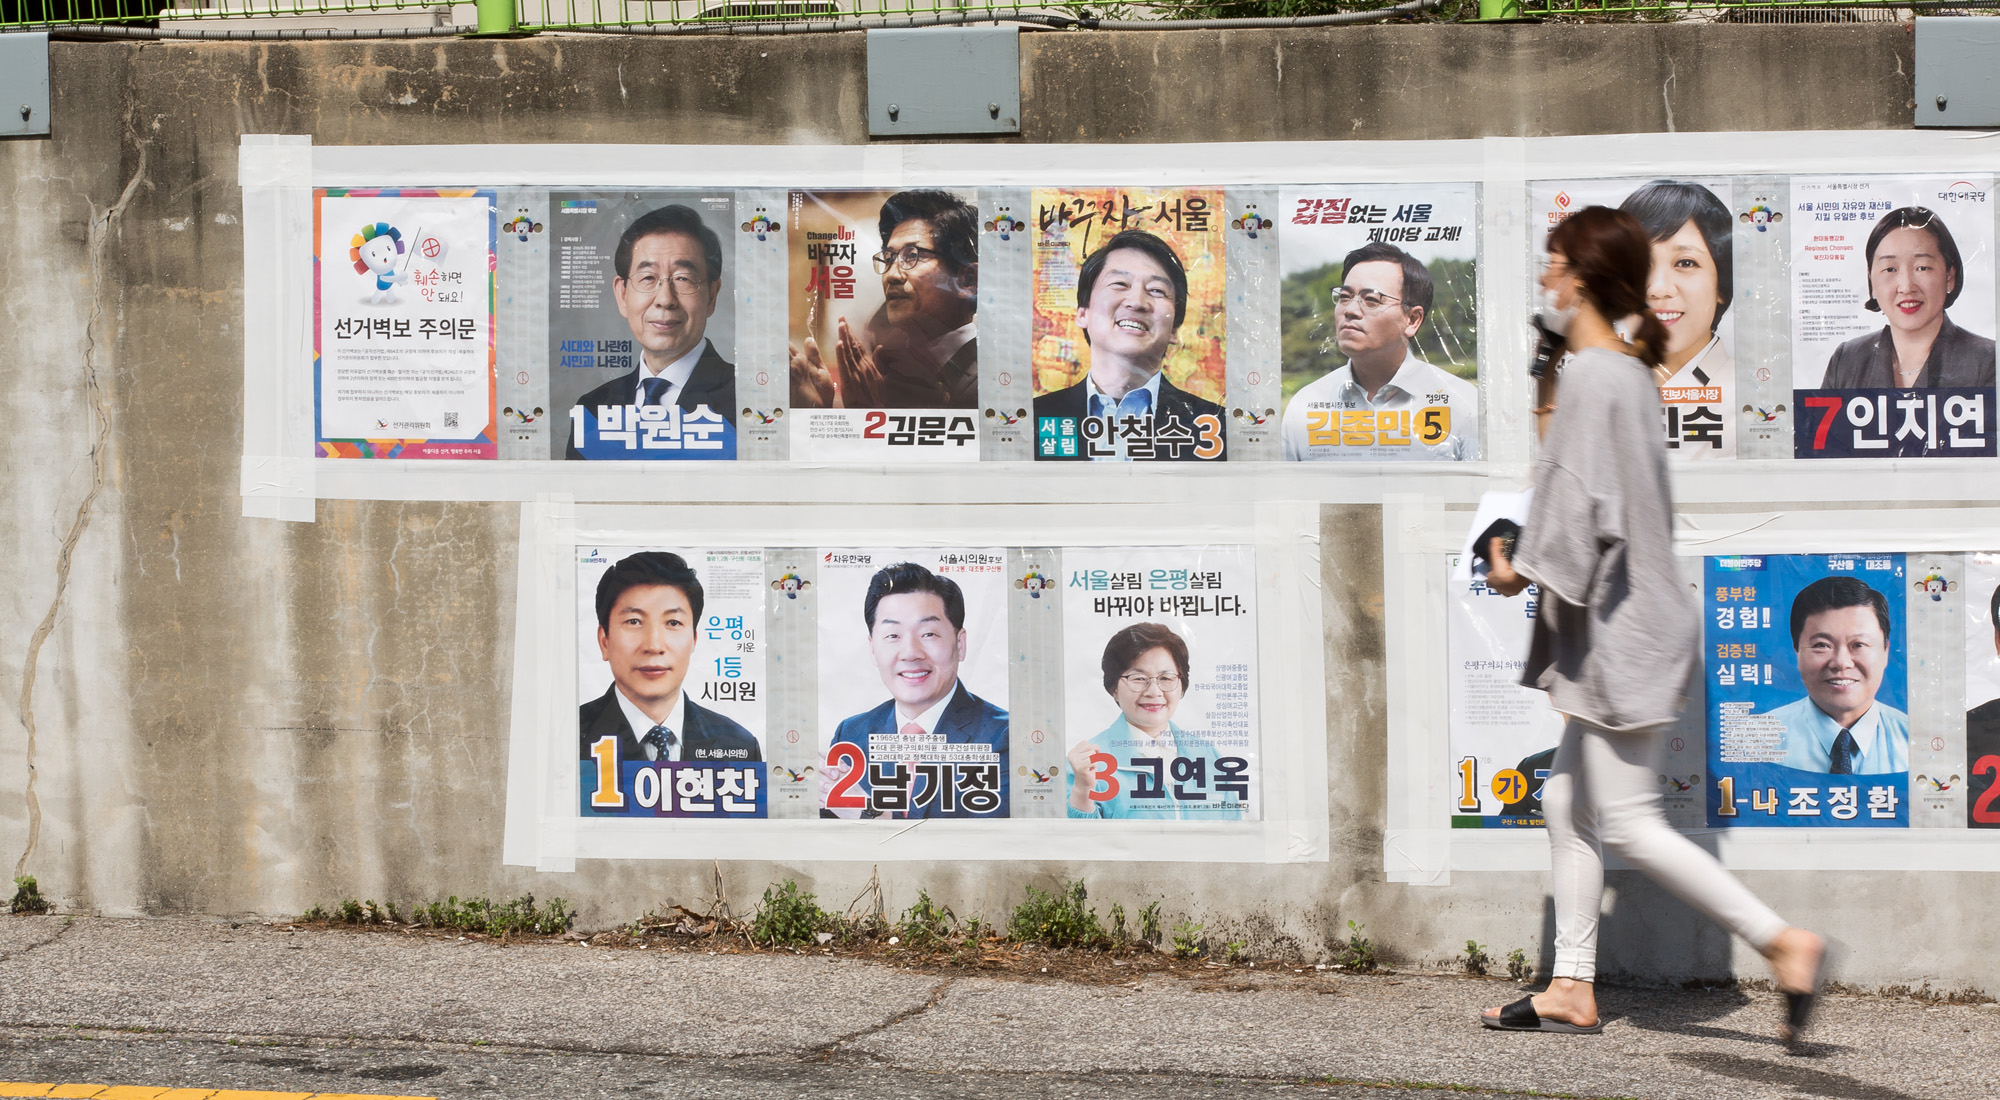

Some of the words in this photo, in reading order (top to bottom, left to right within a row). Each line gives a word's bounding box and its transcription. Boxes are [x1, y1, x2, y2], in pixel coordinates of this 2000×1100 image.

[1938, 191, 1986, 203] 대한애국당
[1392, 204, 1433, 223] 서울
[1798, 203, 1813, 211] 서울
[1816, 202, 1839, 210] 시민의
[1842, 202, 1866, 210] 자유와
[1869, 201, 1892, 210] 재산을
[1548, 212, 1576, 224] 민중
[1815, 213, 1830, 221] 지킬
[1860, 212, 1875, 220] 후보
[1366, 227, 1422, 242] 제1야당
[1424, 226, 1462, 242] 교체!
[807, 243, 857, 265] 바꾸자
[413, 268, 462, 286] 훼손하면
[805, 265, 855, 299] 서울
[421, 288, 435, 302] 안
[438, 290, 464, 303] 돼요!
[334, 317, 412, 340] 선거벽보
[418, 318, 477, 340] 주의문
[560, 340, 594, 353] 시대와
[597, 340, 632, 353] 나란히
[560, 355, 594, 368] 시민과
[597, 355, 632, 368] 나란히
[1426, 394, 1449, 404] 정의당
[1662, 388, 1719, 401] 진보서울시장
[392, 421, 431, 429] 선거관리위원회
[569, 404, 585, 448] 1
[598, 404, 724, 450] 박원순
[864, 411, 886, 439] 2
[888, 416, 976, 446] 김문수
[1041, 418, 1076, 435] 서울
[1306, 410, 1411, 446] 김종민
[1424, 411, 1442, 440] 5
[1804, 396, 1842, 450] 7
[1846, 394, 1986, 449] 인지연
[1081, 414, 1194, 458] 안철수
[1193, 414, 1223, 458] 3
[1042, 438, 1076, 455] 살림
[834, 554, 871, 563] 자유한국당
[1720, 558, 1762, 568] 더불어민주당
[1828, 560, 1854, 570] 구산동
[1866, 560, 1892, 570] 대조동
[1069, 570, 1142, 591] 서울살림
[1148, 569, 1222, 590] 은평살림
[1715, 587, 1756, 601] 풍부한
[1094, 596, 1154, 617] 바꿔야
[1160, 595, 1246, 616] 바뀝니다.
[705, 616, 755, 641] 은평이
[737, 642, 755, 653] 키운
[1716, 644, 1756, 658] 검증된
[714, 657, 742, 678] 1등
[701, 682, 756, 702] 시의원
[918, 734, 946, 742] 공주출생
[695, 750, 707, 758] (현,
[708, 749, 748, 759] 서울시의원)
[875, 753, 910, 761] 고려대학교
[913, 753, 947, 761] 정책대학원
[590, 735, 624, 808] 1
[633, 767, 760, 813] 이현찬
[826, 741, 866, 810] 2
[868, 763, 1001, 812] 남기정
[1088, 753, 1120, 801] 3
[1130, 757, 1249, 800] 고연옥
[1787, 786, 1899, 819] 조정환
